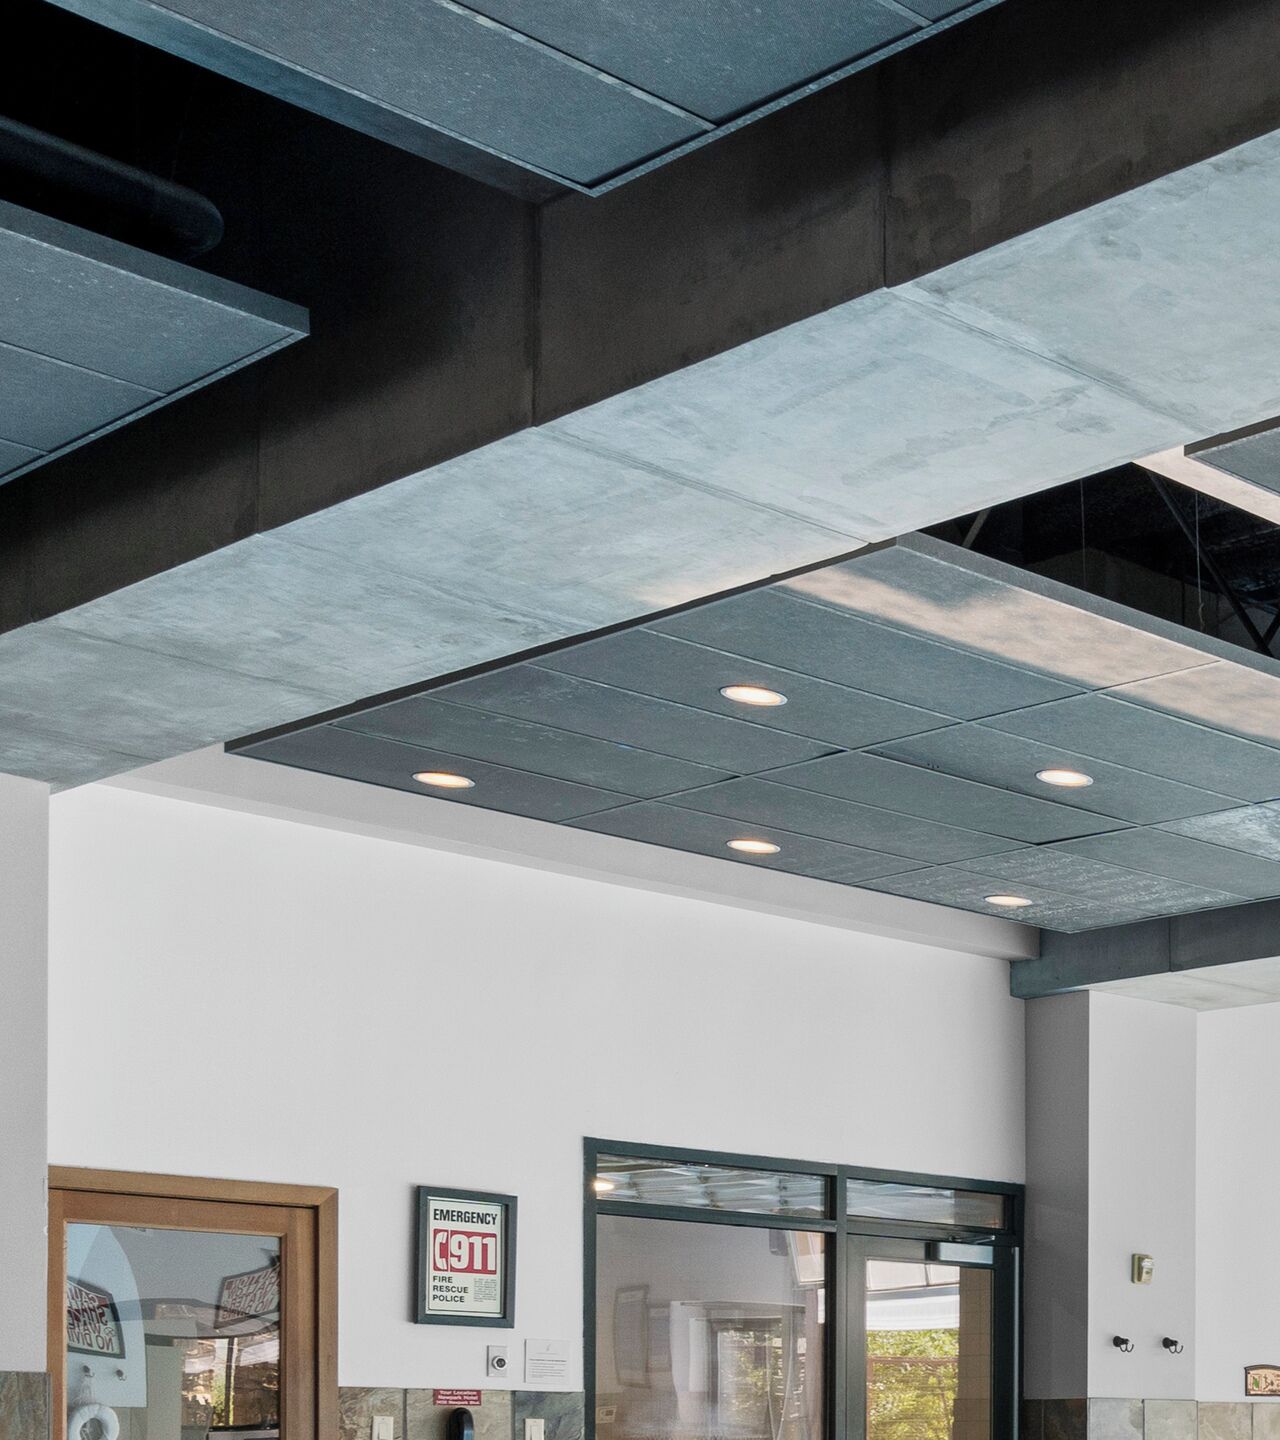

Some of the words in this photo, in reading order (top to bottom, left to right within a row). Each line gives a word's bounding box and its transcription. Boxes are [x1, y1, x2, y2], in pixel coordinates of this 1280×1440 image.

[433, 1208, 498, 1225] EMERGENCY
[450, 1233, 497, 1271] 911
[432, 1275, 453, 1284] FIRE
[432, 1285, 469, 1294] RESCUE
[432, 1294, 465, 1303] POLICE
